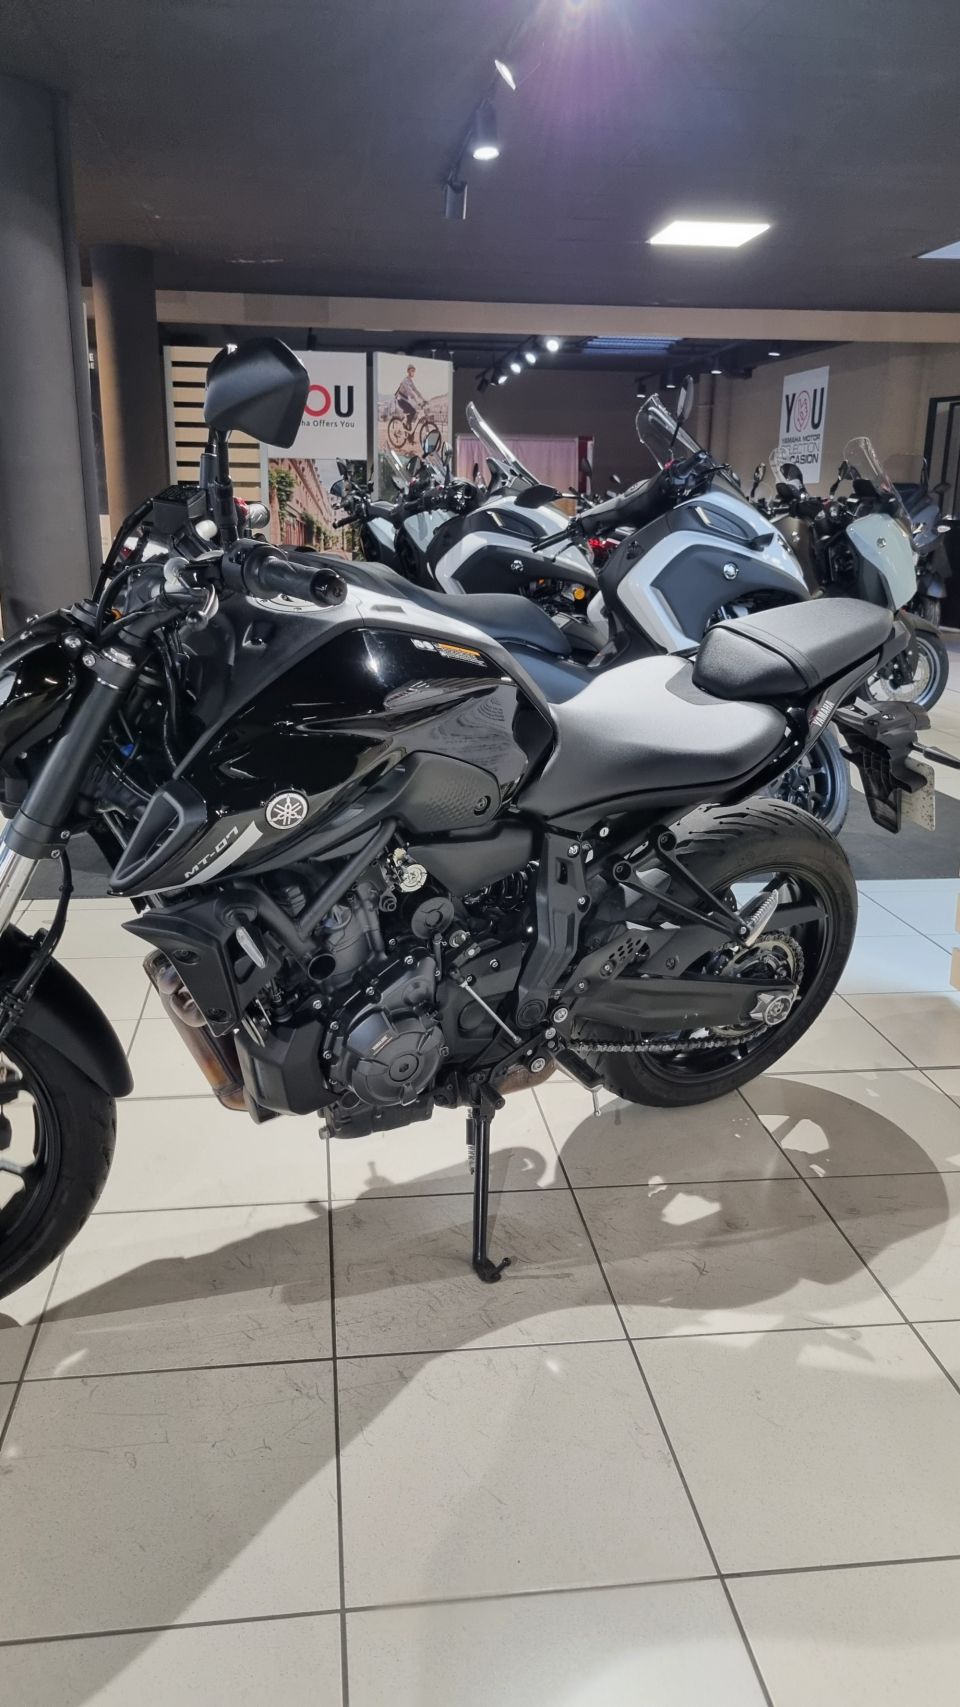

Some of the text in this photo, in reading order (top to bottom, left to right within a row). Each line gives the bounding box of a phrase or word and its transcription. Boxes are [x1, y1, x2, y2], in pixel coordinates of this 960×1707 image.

[304, 384, 354, 418] OU
[785, 387, 825, 433] YOU
[313, 420, 338, 428] Offers
[340, 420, 355, 428] You
[802, 433, 821, 442] MOTOR
[812, 700, 835, 727] YAMAHA
[184, 826, 239, 878] MT-07
